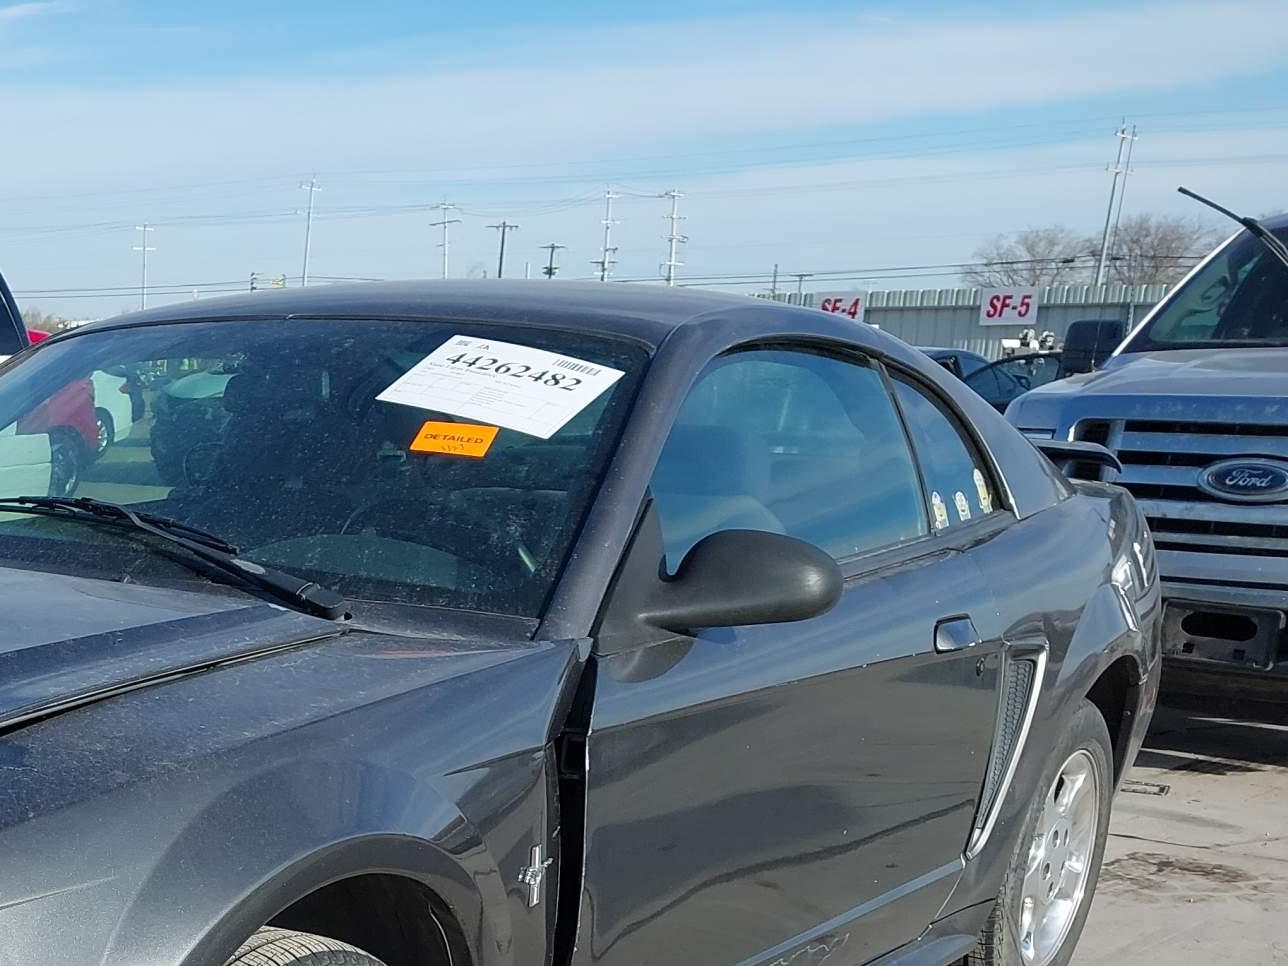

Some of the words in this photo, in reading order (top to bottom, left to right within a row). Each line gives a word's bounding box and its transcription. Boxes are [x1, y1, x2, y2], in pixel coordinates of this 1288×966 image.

[986, 294, 1033, 318] SF-5
[445, 352, 583, 391] 44262482
[423, 433, 484, 444] DETAILED
[1224, 468, 1273, 487] Ford
